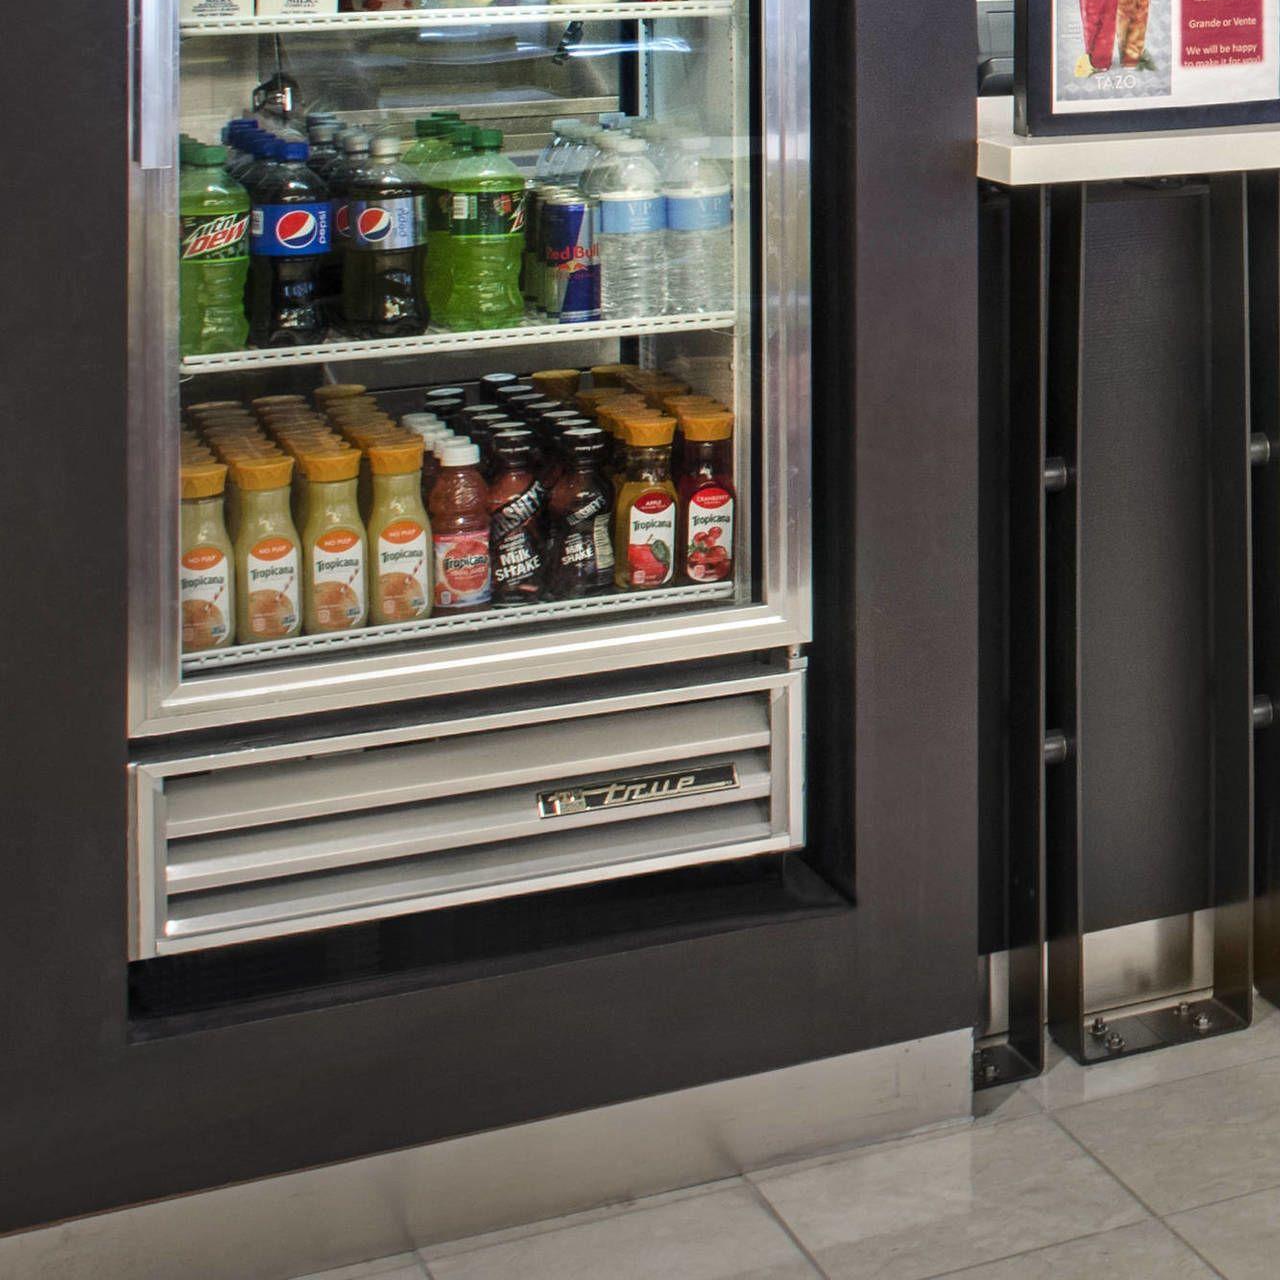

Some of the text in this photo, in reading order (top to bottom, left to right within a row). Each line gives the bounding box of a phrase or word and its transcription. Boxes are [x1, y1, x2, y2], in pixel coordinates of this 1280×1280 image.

[1188, 19, 1221, 28] Grande
[1233, 17, 1257, 26] Vente
[1185, 43, 1257, 55] We will be happy
[1095, 74, 1138, 90] TAZO
[632, 519, 672, 531] Tropicana
[692, 514, 731, 526] Tropicana
[379, 548, 424, 564] Tropicana
[499, 548, 531, 566] Milk
[251, 565, 294, 580] Tropicana
[316, 558, 359, 573] Tropicana
[495, 554, 542, 582] SHAKE
[603, 775, 696, 805] true
